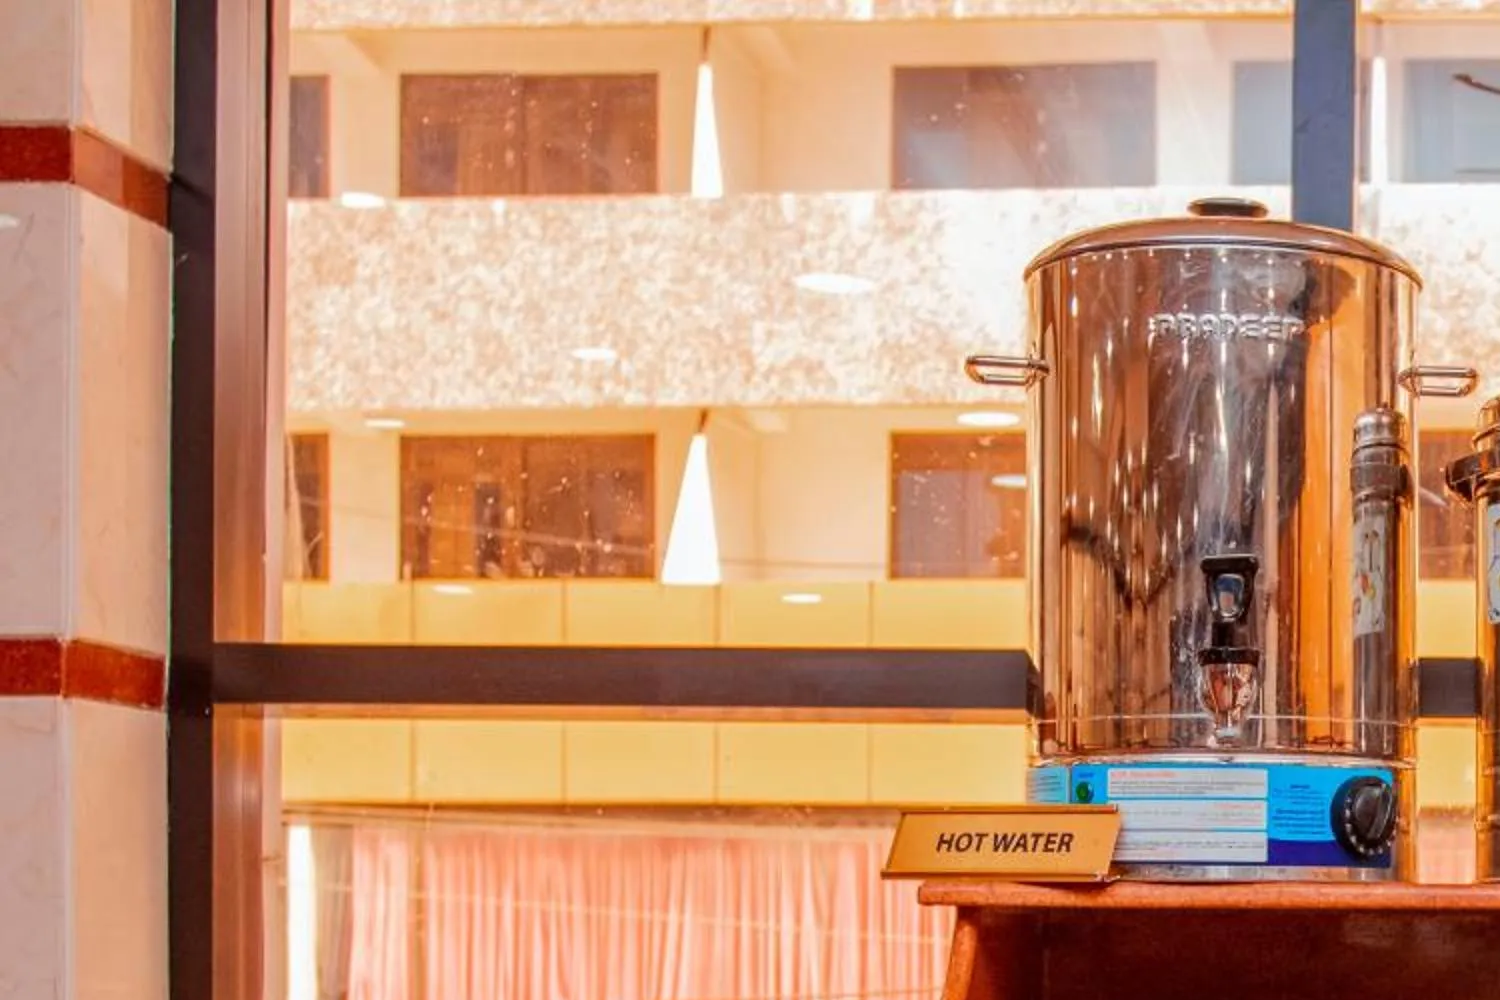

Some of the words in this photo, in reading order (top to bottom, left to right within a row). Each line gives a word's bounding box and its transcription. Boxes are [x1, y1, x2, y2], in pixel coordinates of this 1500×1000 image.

[1153, 312, 1305, 340] PRADEEP
[936, 832, 989, 853] HOT
[992, 832, 1074, 853] WATER
